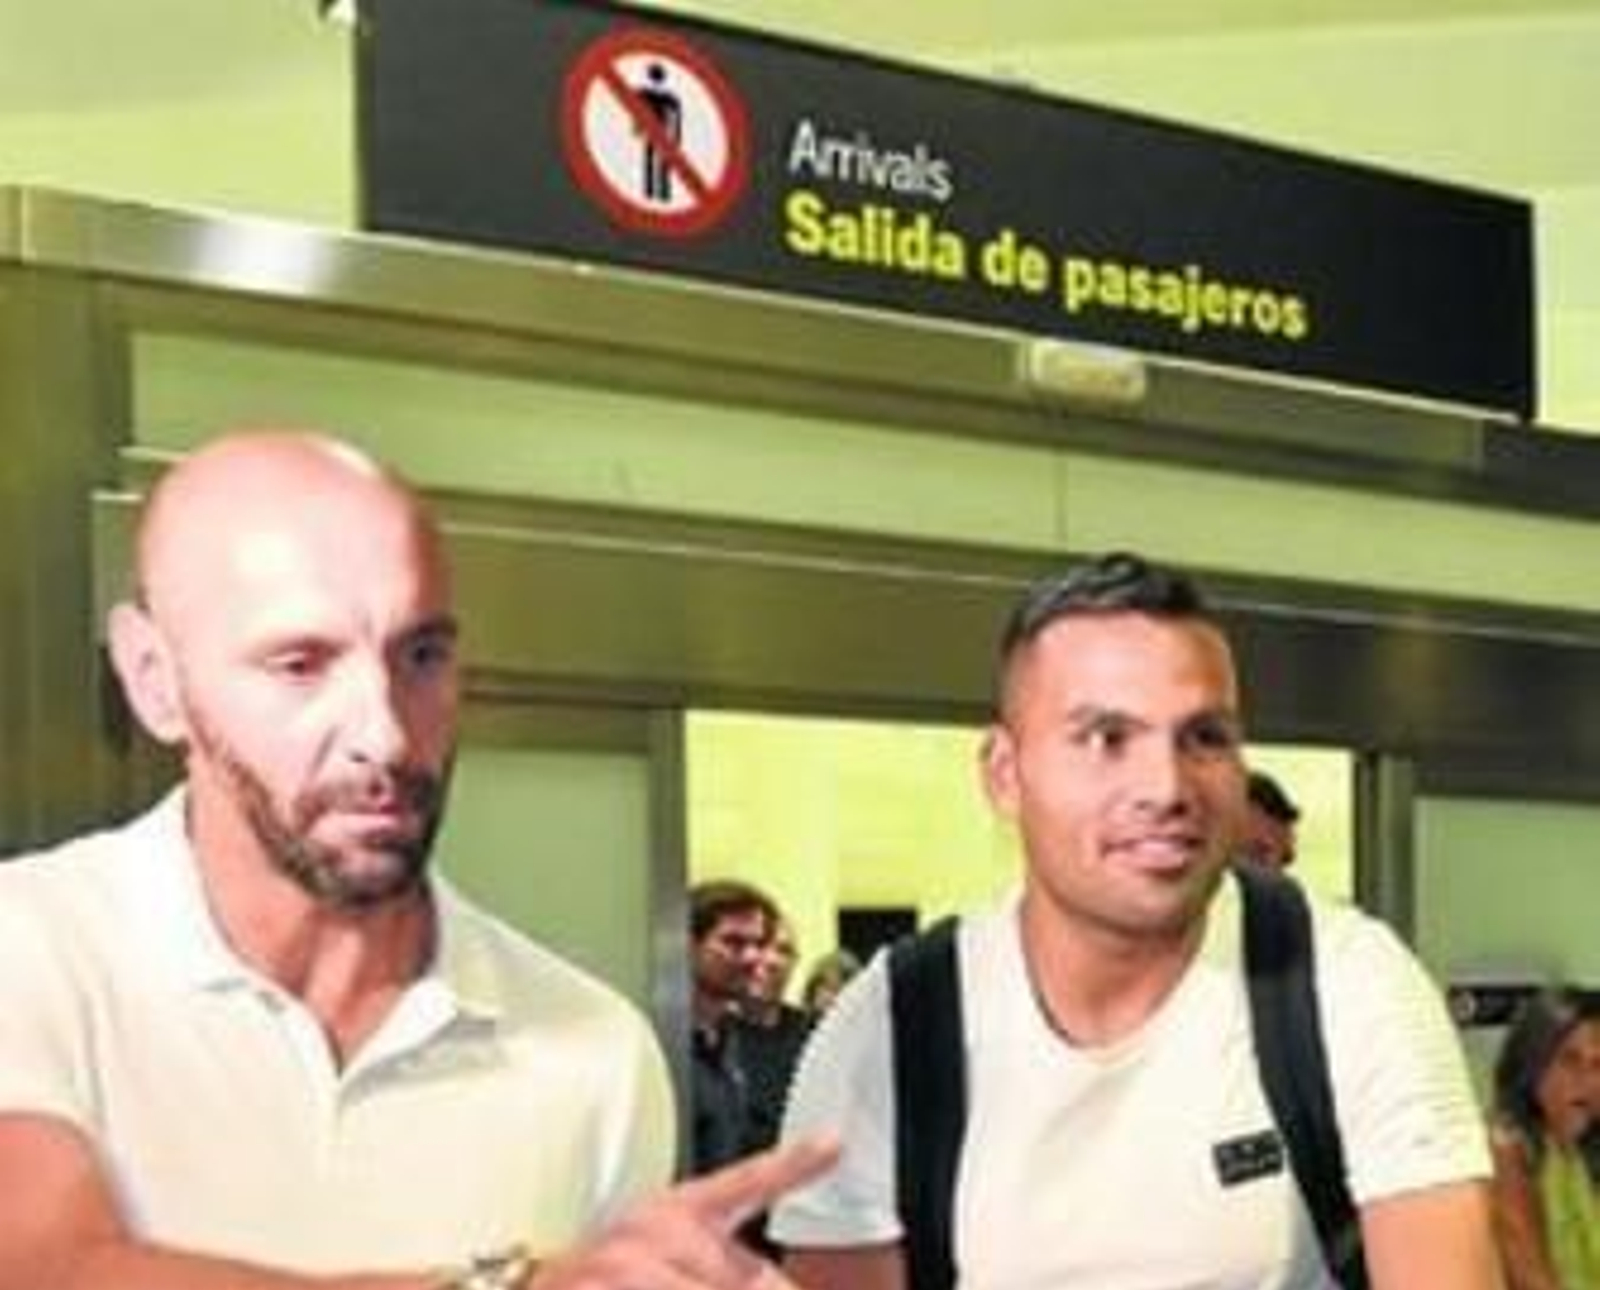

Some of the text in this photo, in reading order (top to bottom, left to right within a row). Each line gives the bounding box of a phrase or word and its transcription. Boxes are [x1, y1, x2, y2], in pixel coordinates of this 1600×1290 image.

[788, 119, 953, 200] Arrivals
[784, 190, 1307, 338] Salida de pasajeros
